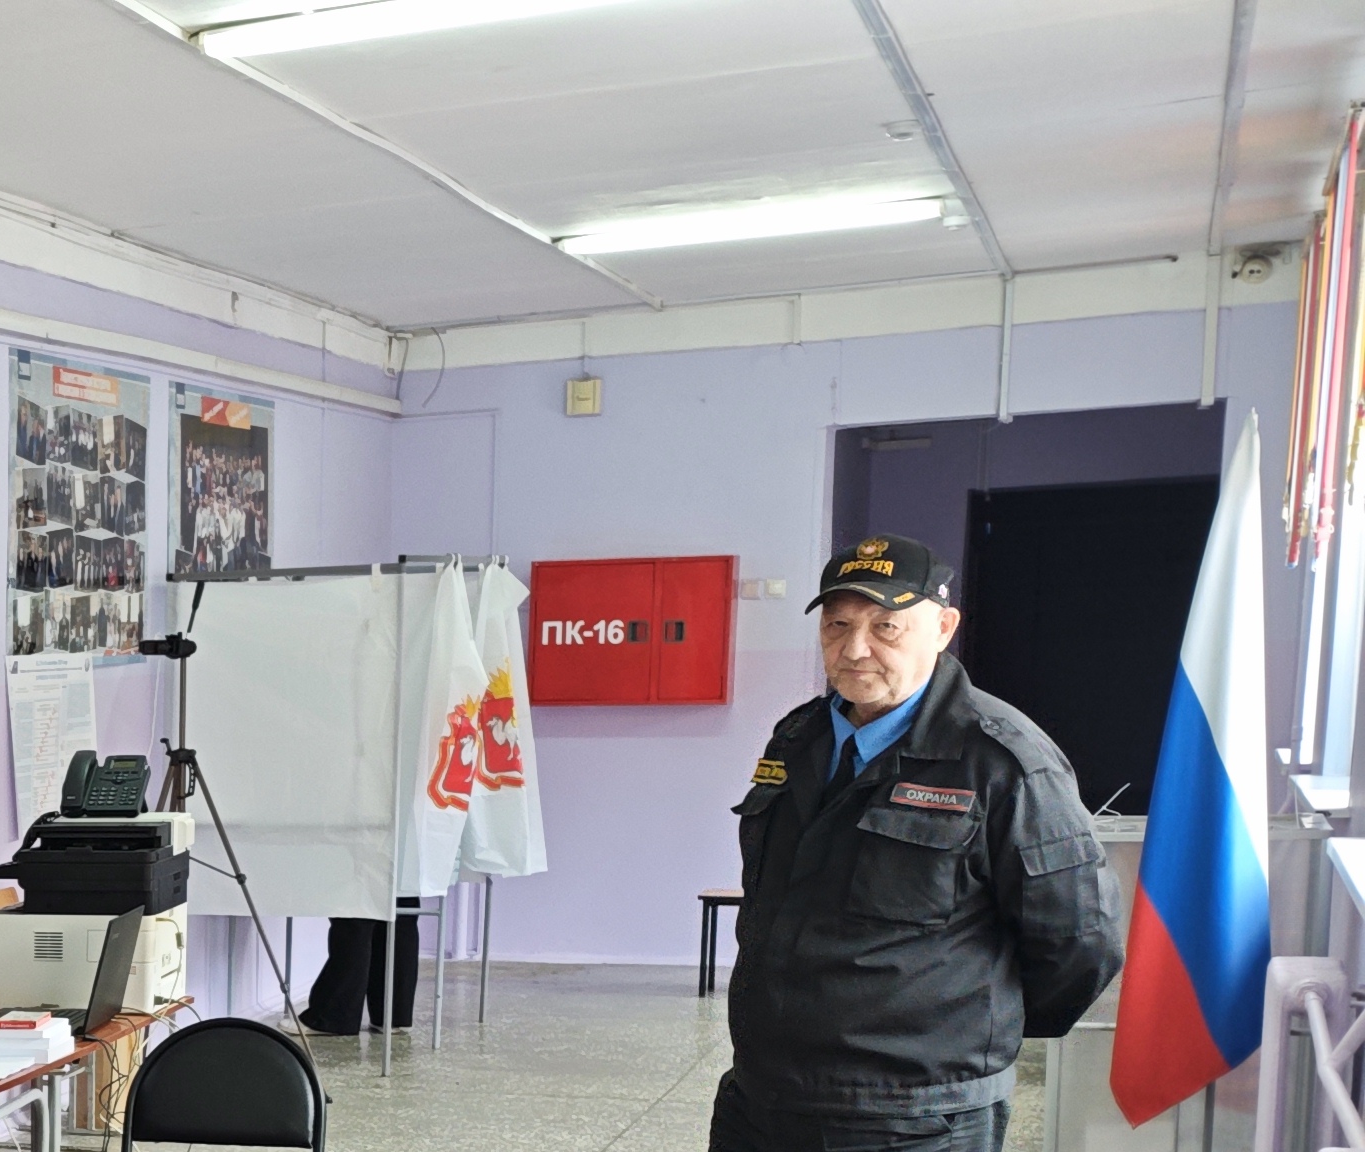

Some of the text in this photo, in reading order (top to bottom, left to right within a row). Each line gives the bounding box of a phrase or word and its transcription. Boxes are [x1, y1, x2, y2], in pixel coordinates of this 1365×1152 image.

[837, 560, 894, 578] РОССИЯ
[541, 619, 625, 645] ПК-16
[906, 790, 957, 805] ОХРАНА
